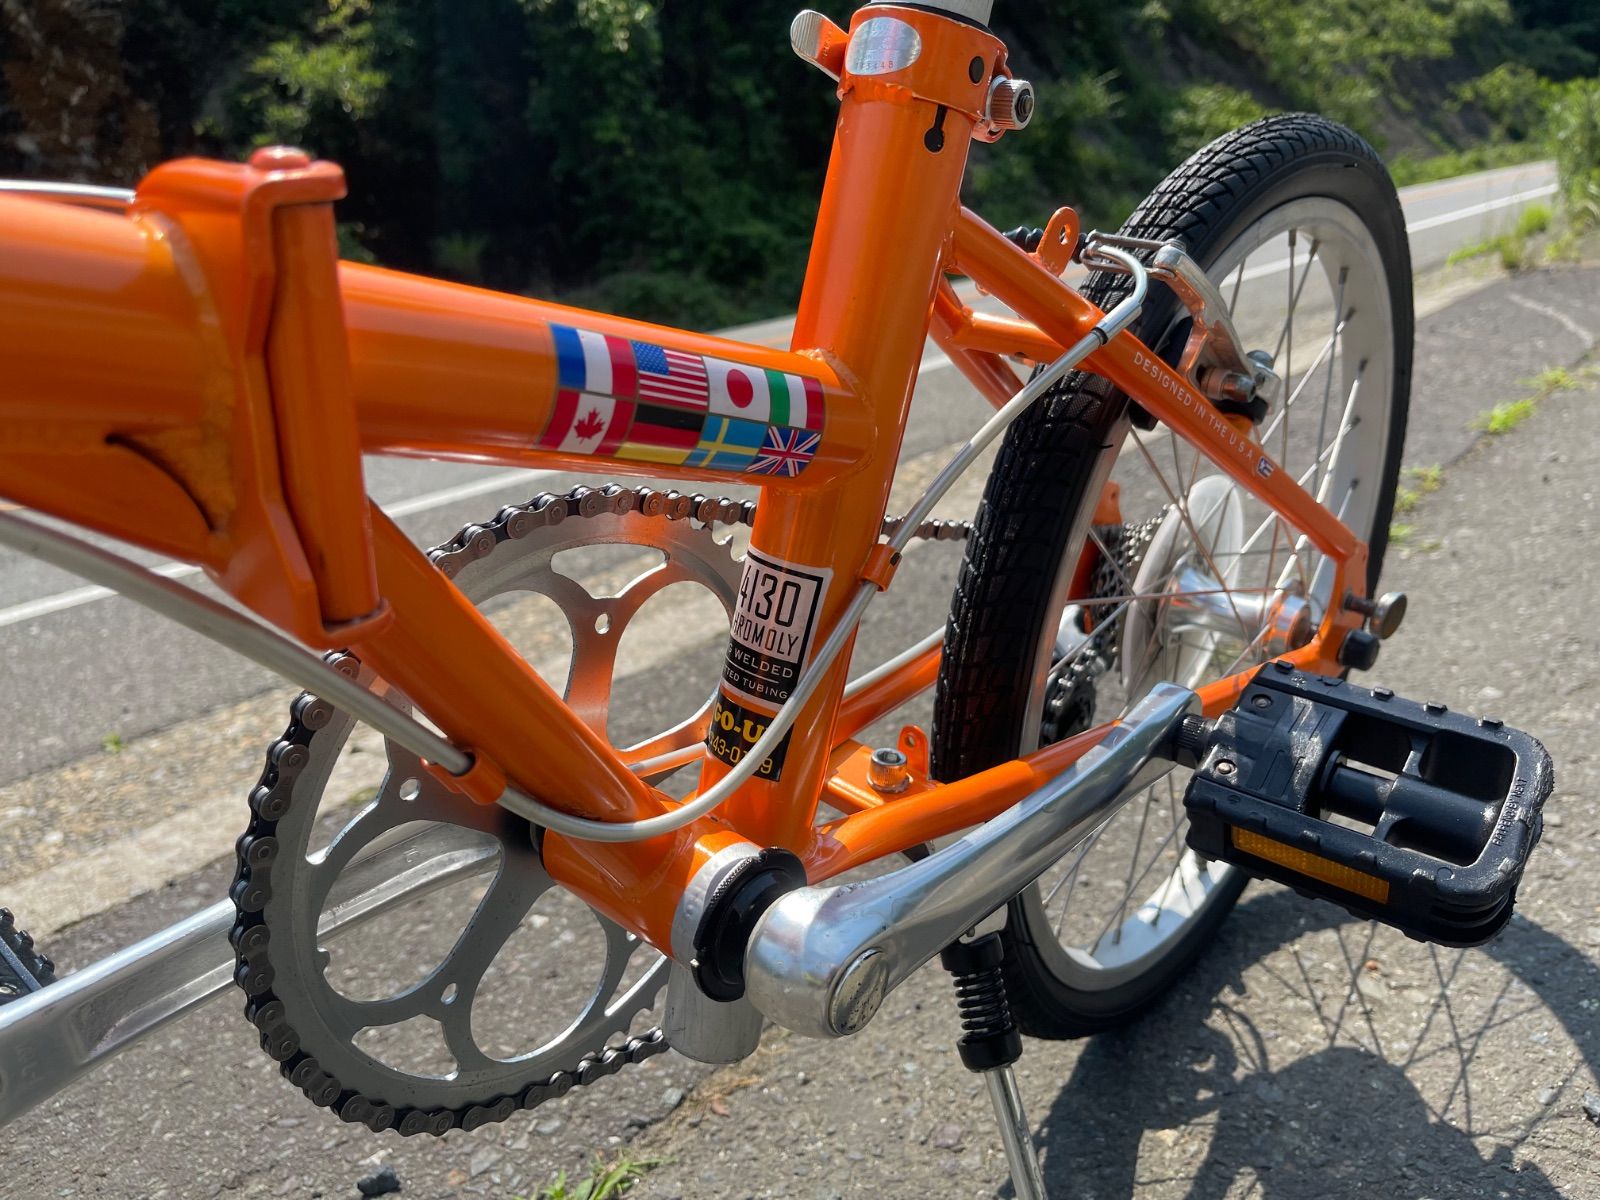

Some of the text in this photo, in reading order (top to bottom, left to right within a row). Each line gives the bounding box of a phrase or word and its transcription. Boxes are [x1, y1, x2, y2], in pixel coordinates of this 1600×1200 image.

[1133, 352, 1192, 406] DESIGNED
[1194, 402, 1206, 418] IN
[1209, 414, 1227, 438] THE
[741, 565, 801, 627] 4130
[733, 611, 799, 656] HROMOLY
[734, 649, 793, 678] WELDED
[743, 678, 787, 699] TUBING
